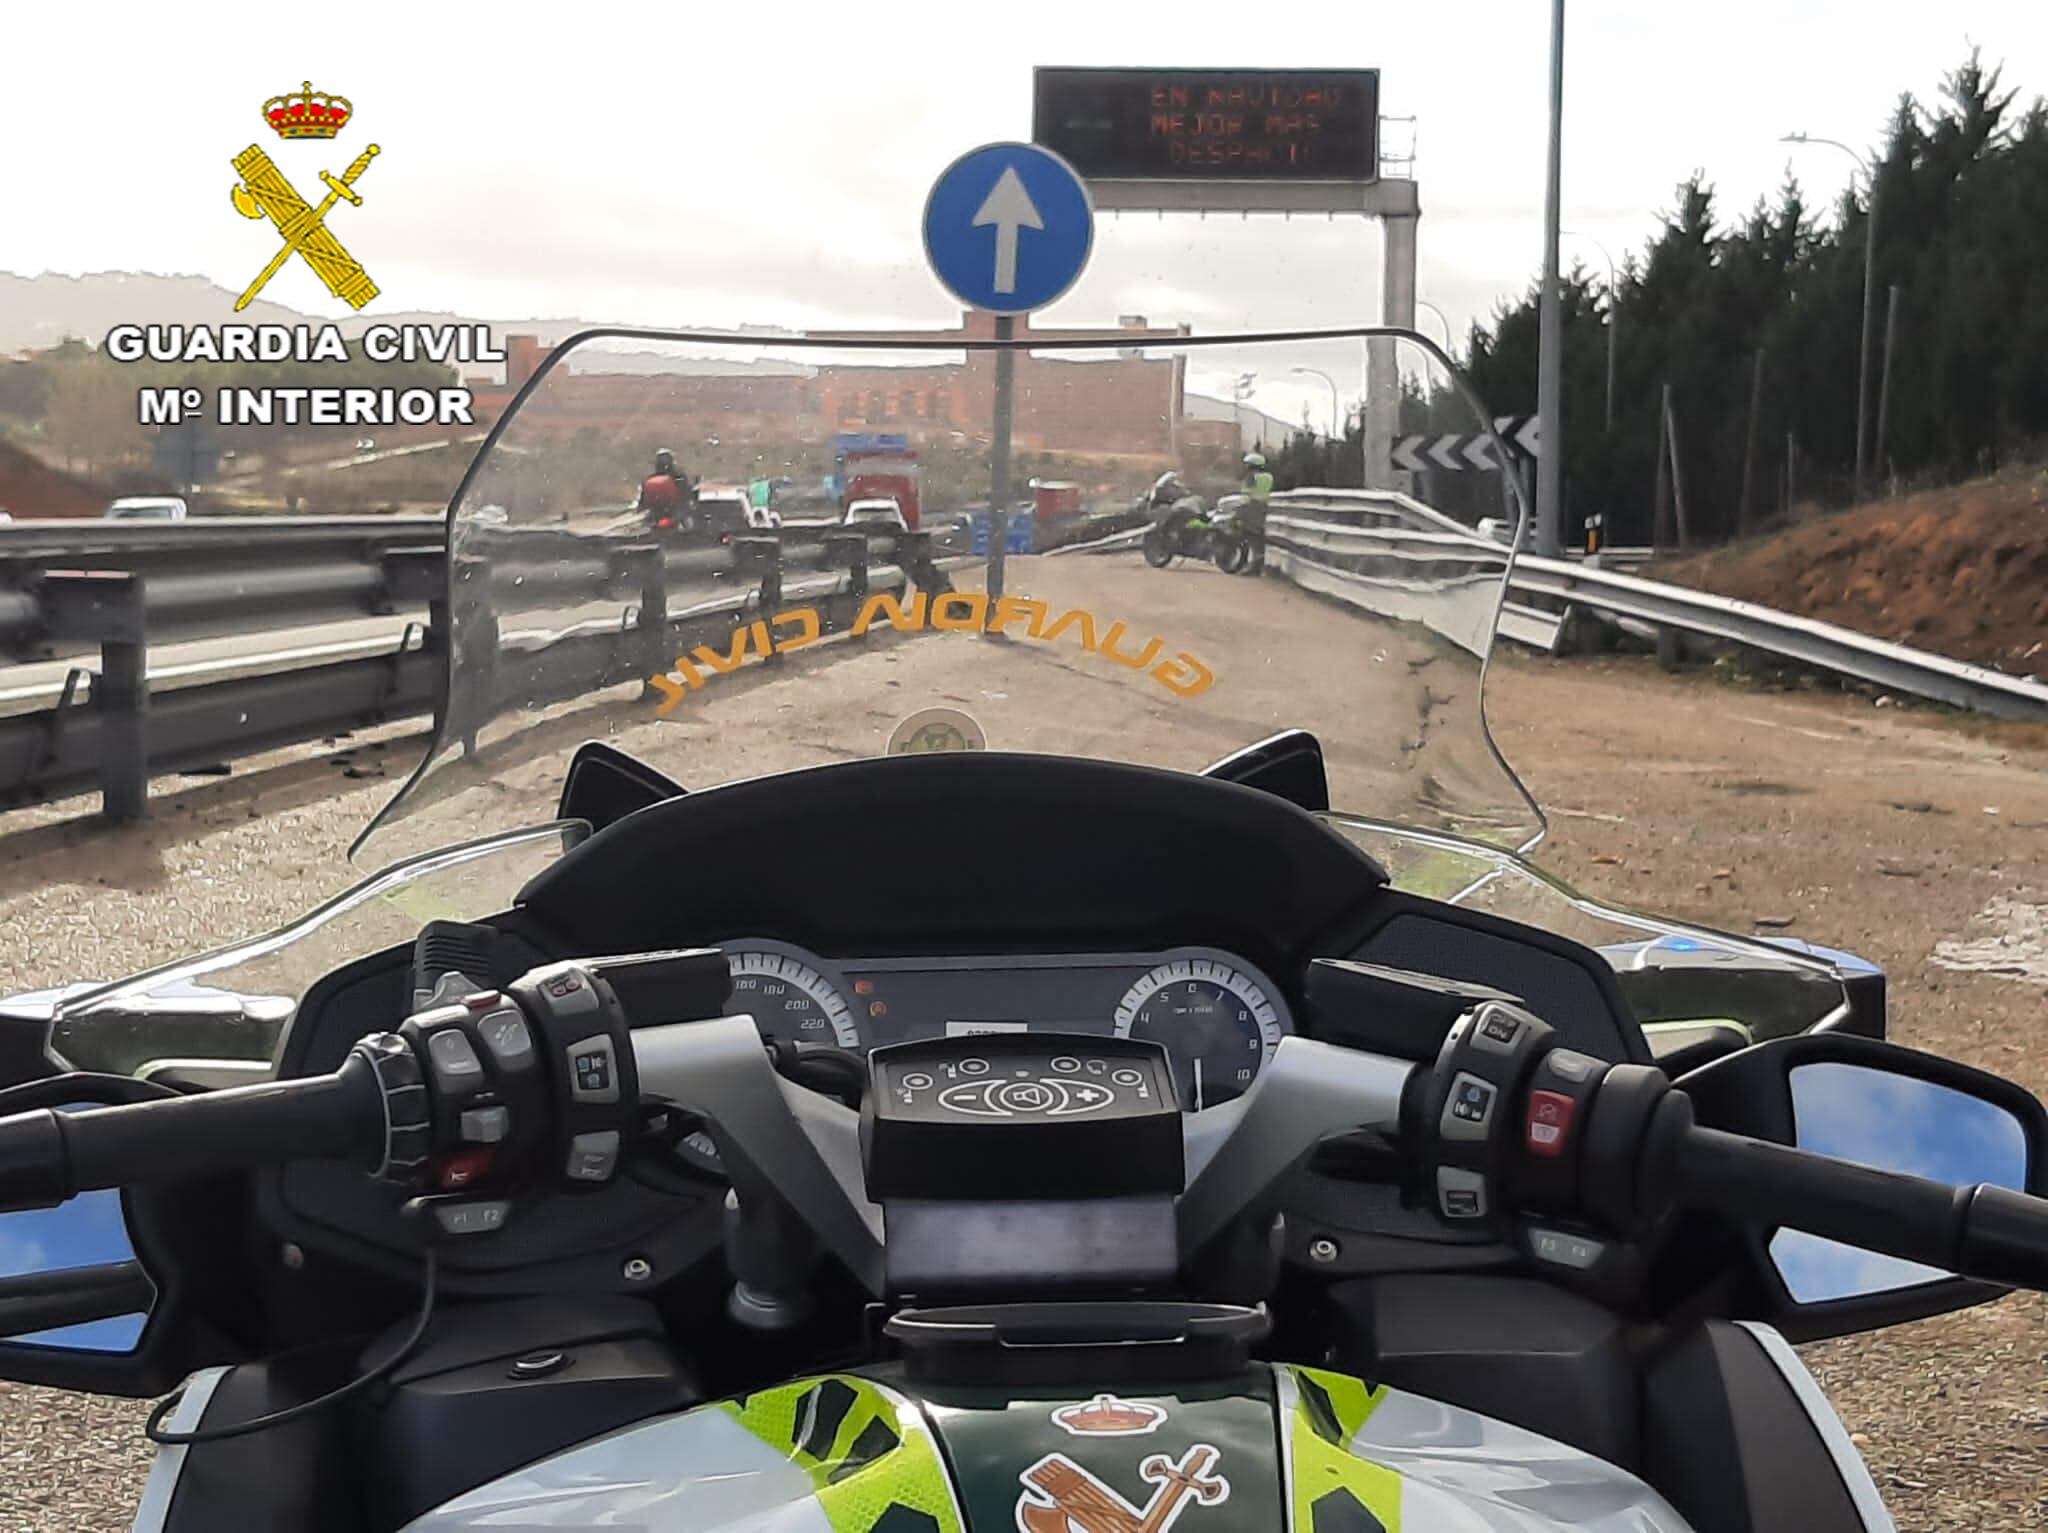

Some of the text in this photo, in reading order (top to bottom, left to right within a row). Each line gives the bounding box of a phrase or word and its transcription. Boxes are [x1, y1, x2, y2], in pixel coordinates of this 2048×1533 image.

[1151, 87, 1187, 107] EN
[1159, 991, 1169, 1002] 5
[1215, 990, 1225, 1001] 7
[784, 999, 810, 1011] 200
[800, 1018, 825, 1029] 220
[1248, 1038, 1258, 1049] 9
